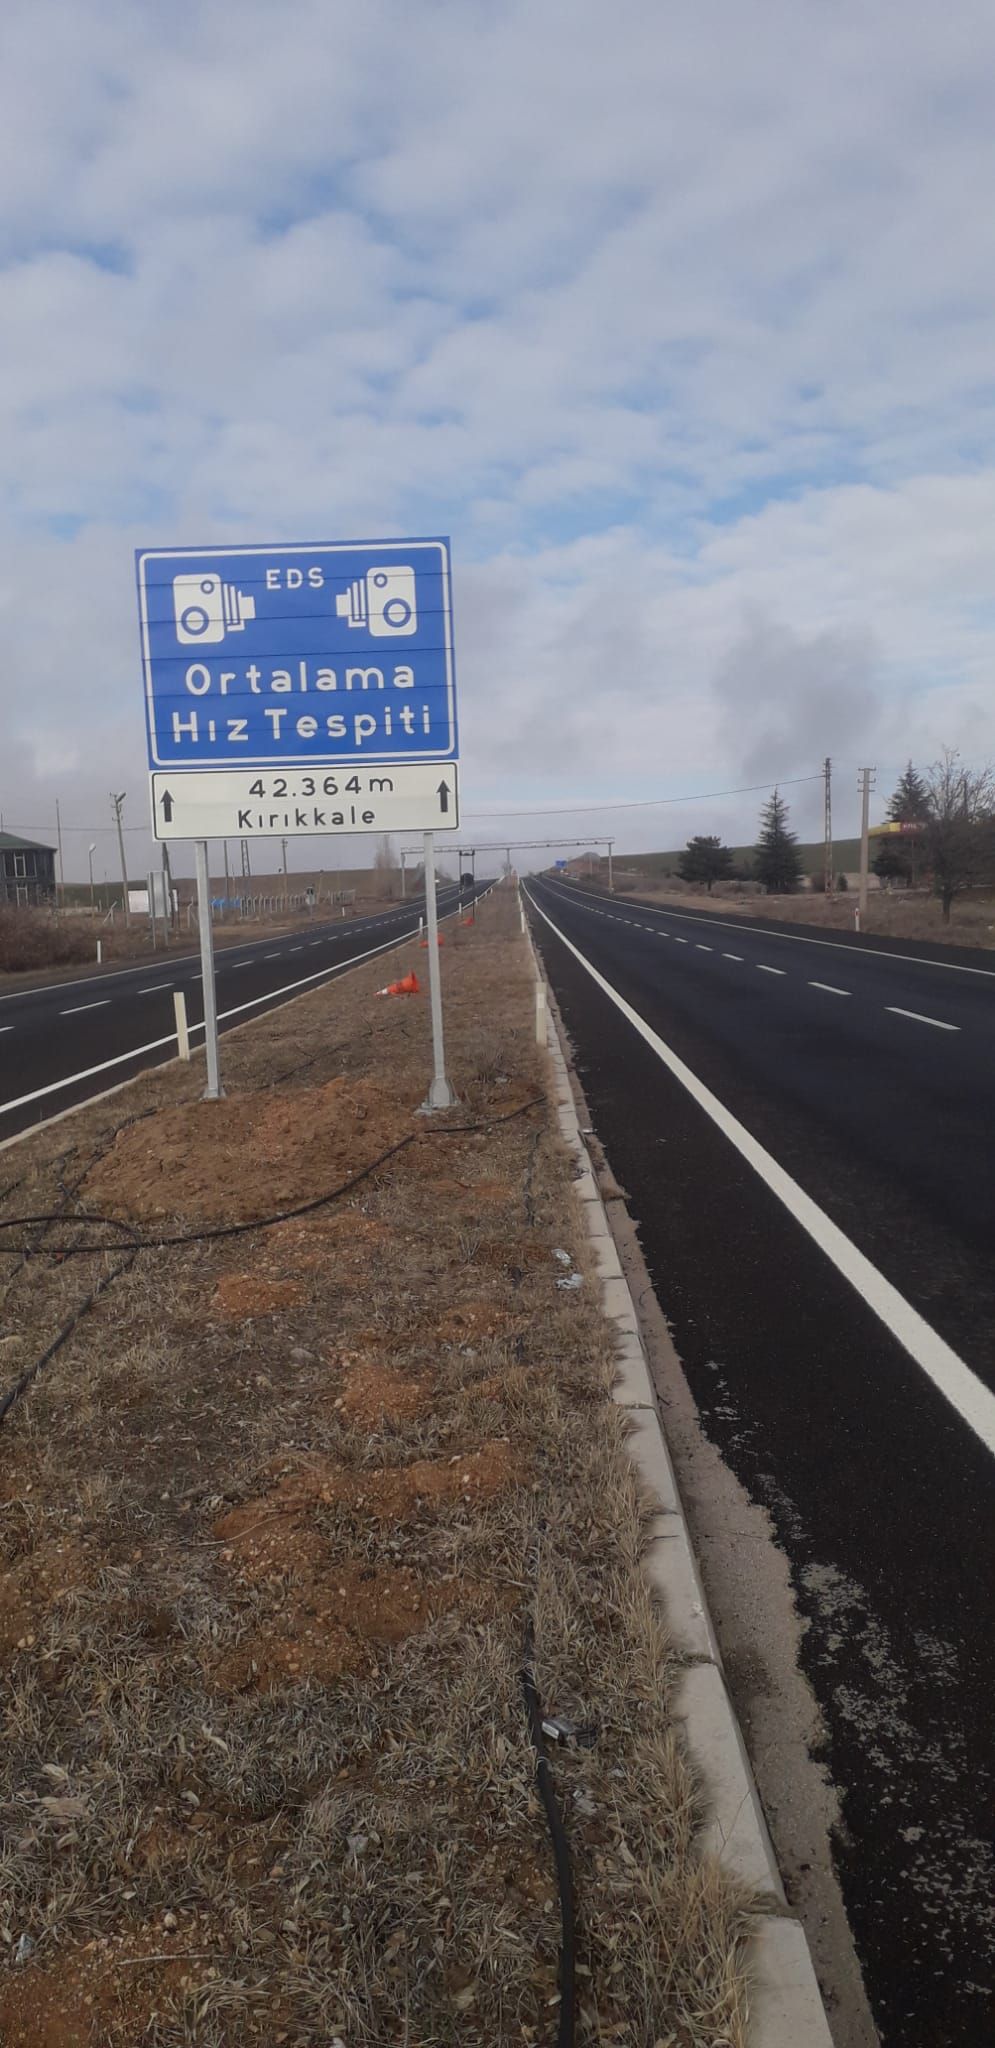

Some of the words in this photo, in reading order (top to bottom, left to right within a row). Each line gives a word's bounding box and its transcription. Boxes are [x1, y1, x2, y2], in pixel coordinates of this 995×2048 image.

[266, 567, 325, 590] EDS
[185, 661, 415, 696] Ortalama
[172, 711, 249, 743] Hız
[264, 704, 431, 746] Tespiti
[238, 806, 376, 829] Kırıkkale
